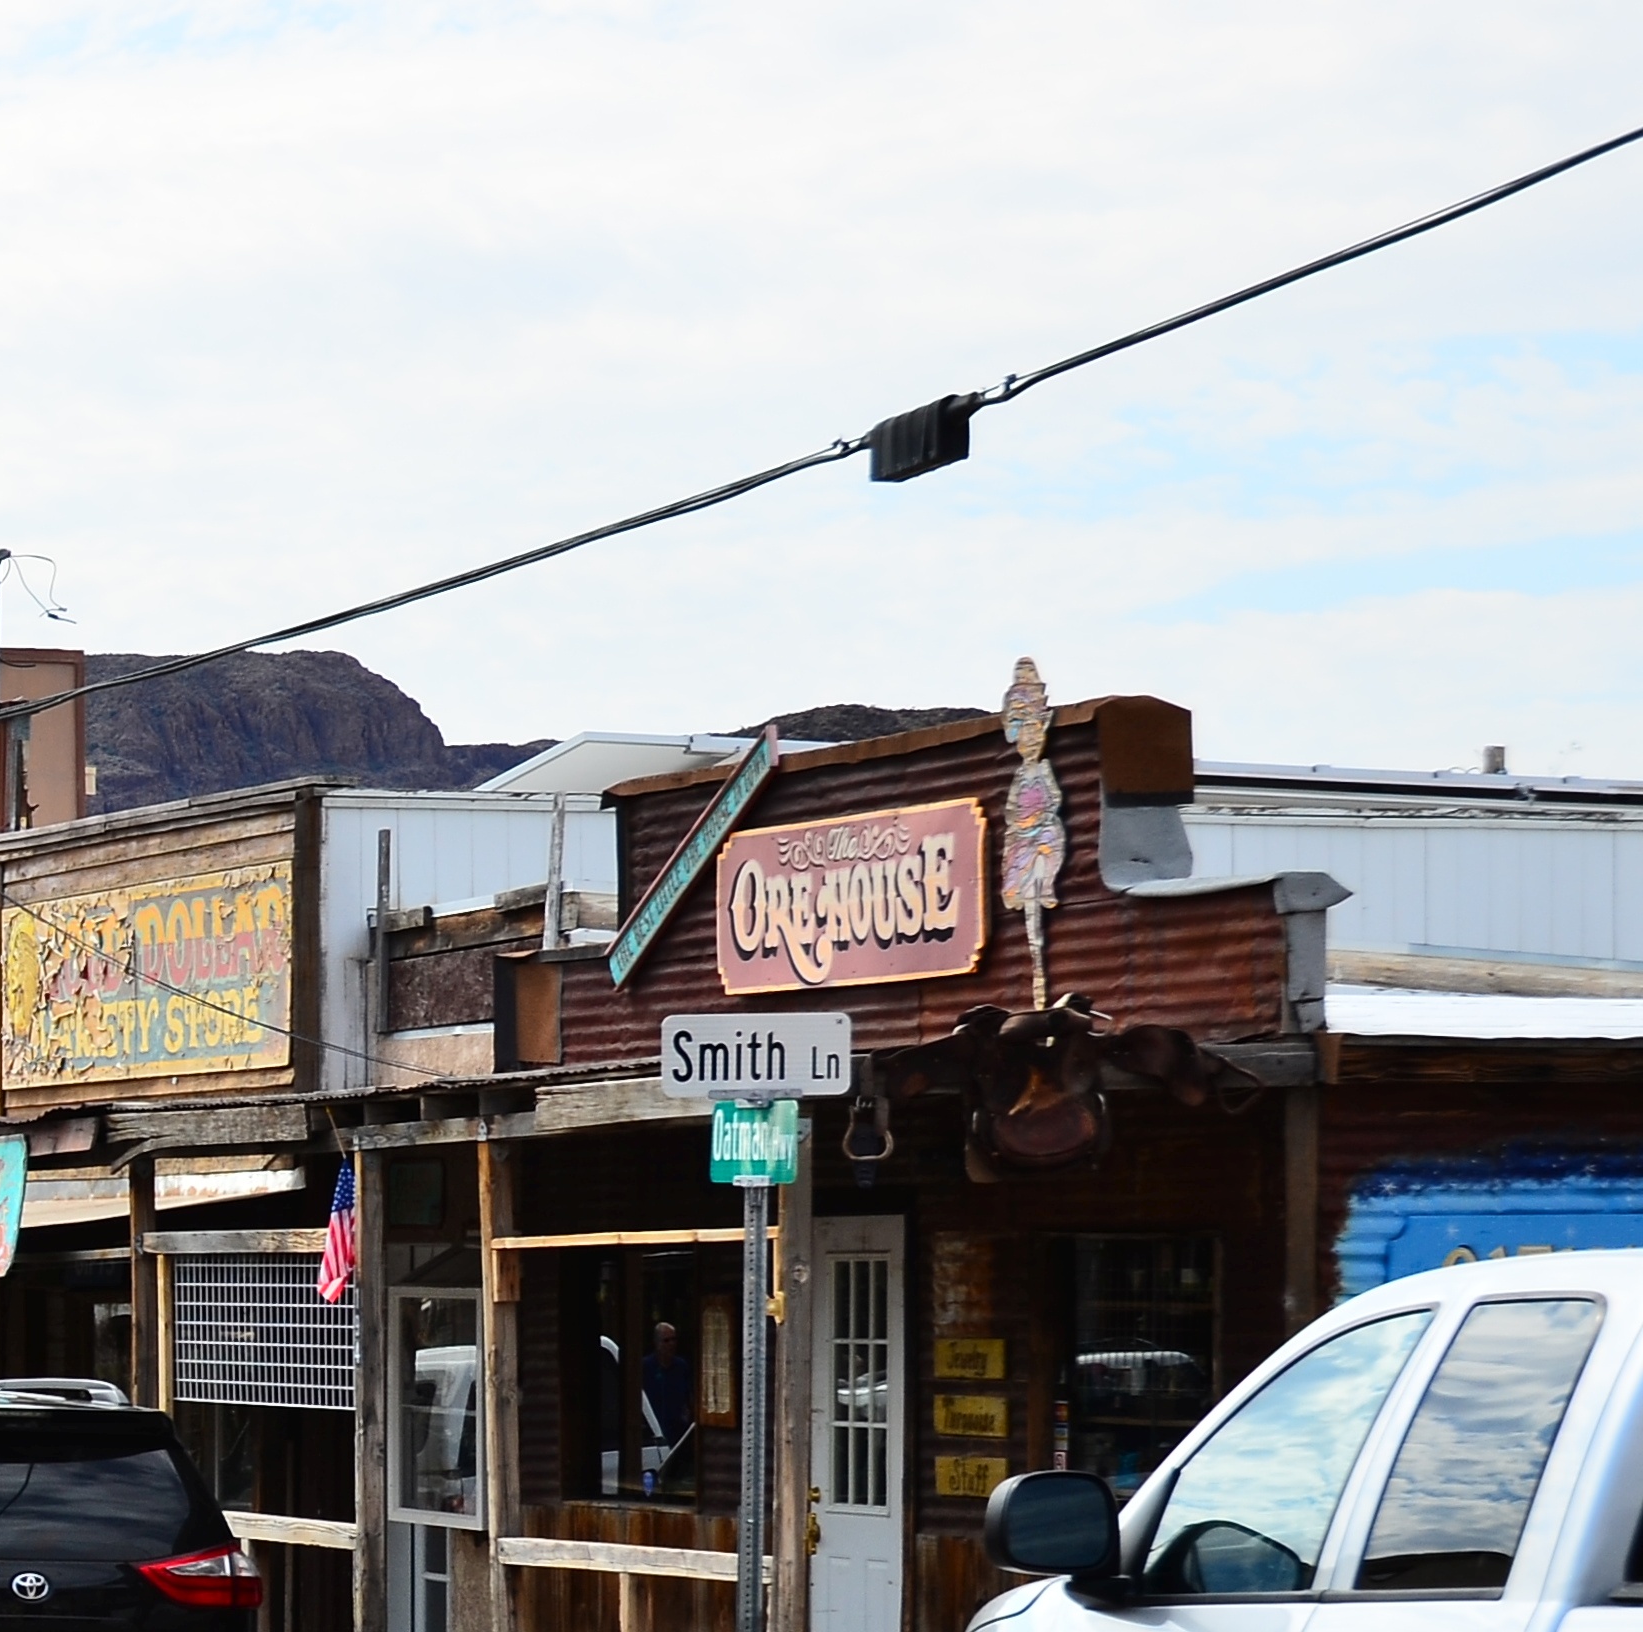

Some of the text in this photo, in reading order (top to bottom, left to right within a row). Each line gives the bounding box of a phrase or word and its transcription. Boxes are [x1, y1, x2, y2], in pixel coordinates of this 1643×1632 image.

[164, 985, 264, 1054] STORE
[672, 1030, 840, 1083] Smith Ln
[713, 1109, 769, 1161] Oatman
[949, 1458, 989, 1494] Stuff
